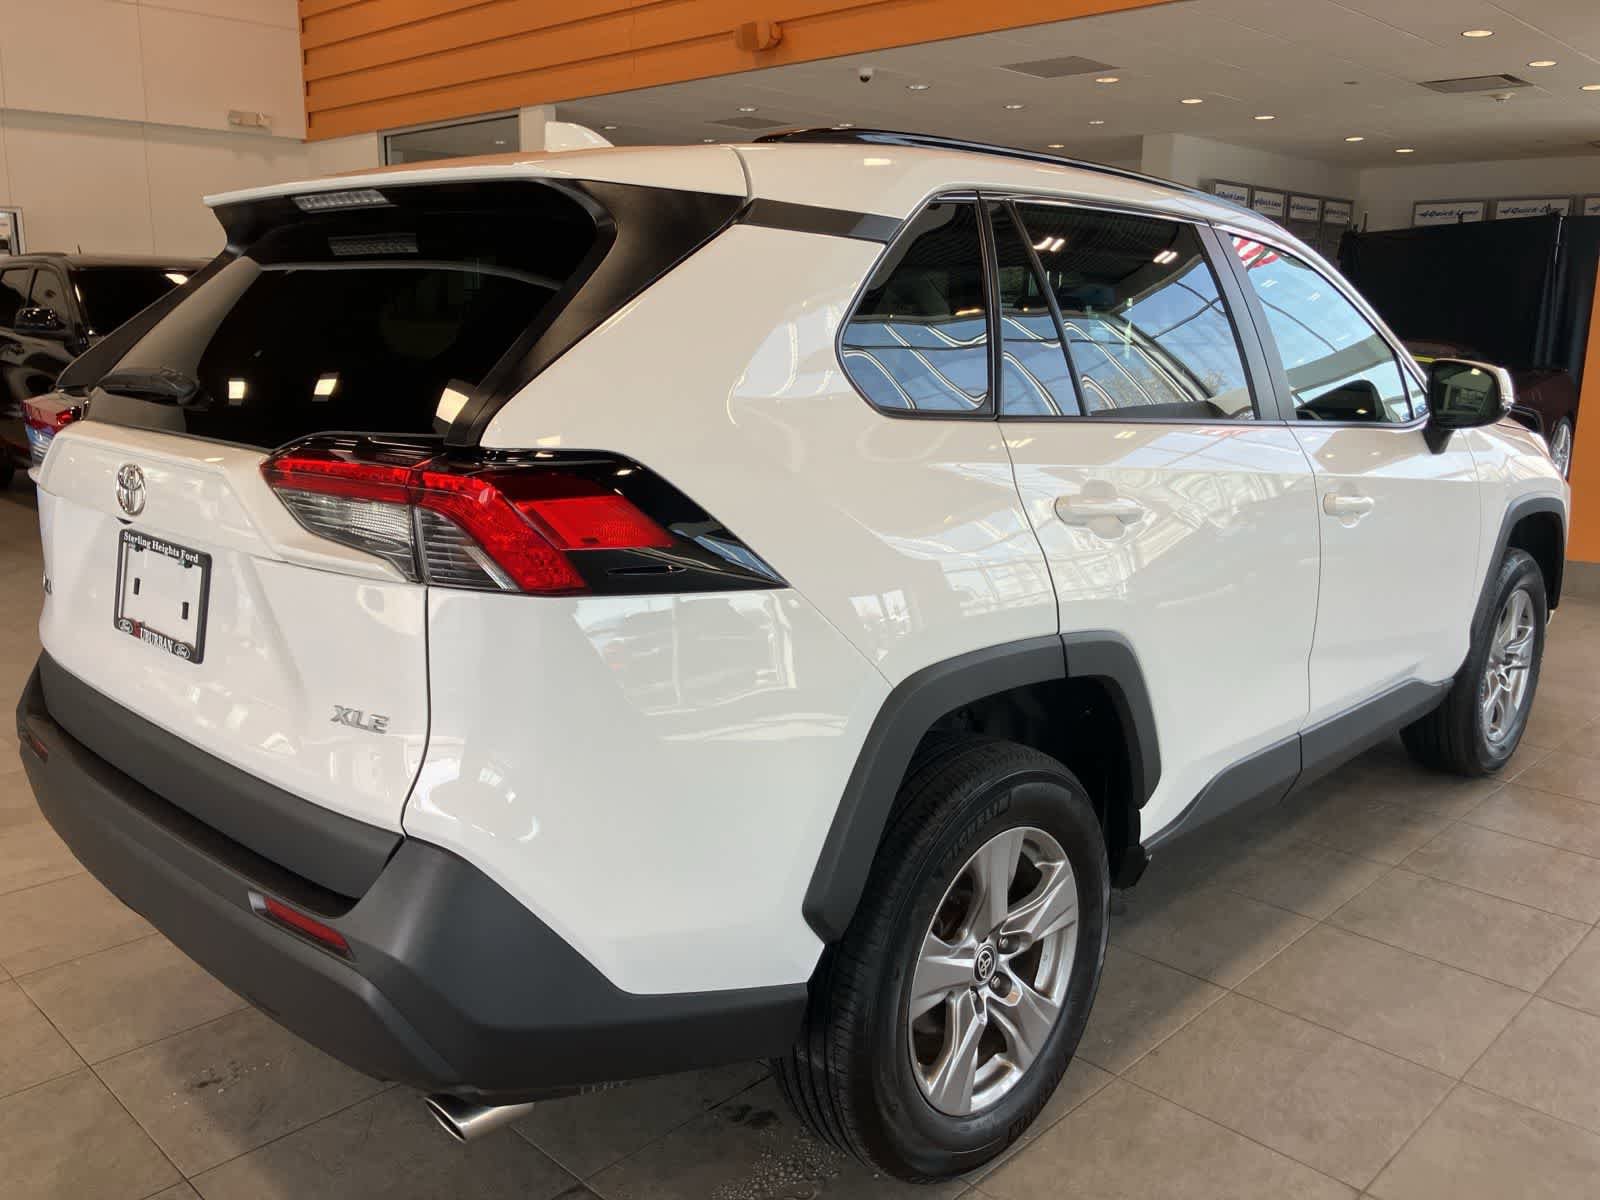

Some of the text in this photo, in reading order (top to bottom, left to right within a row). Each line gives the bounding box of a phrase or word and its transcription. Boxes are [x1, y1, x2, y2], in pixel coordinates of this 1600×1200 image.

[123, 531, 199, 564] Sterling Heights Ford
[330, 704, 389, 734] XLE
